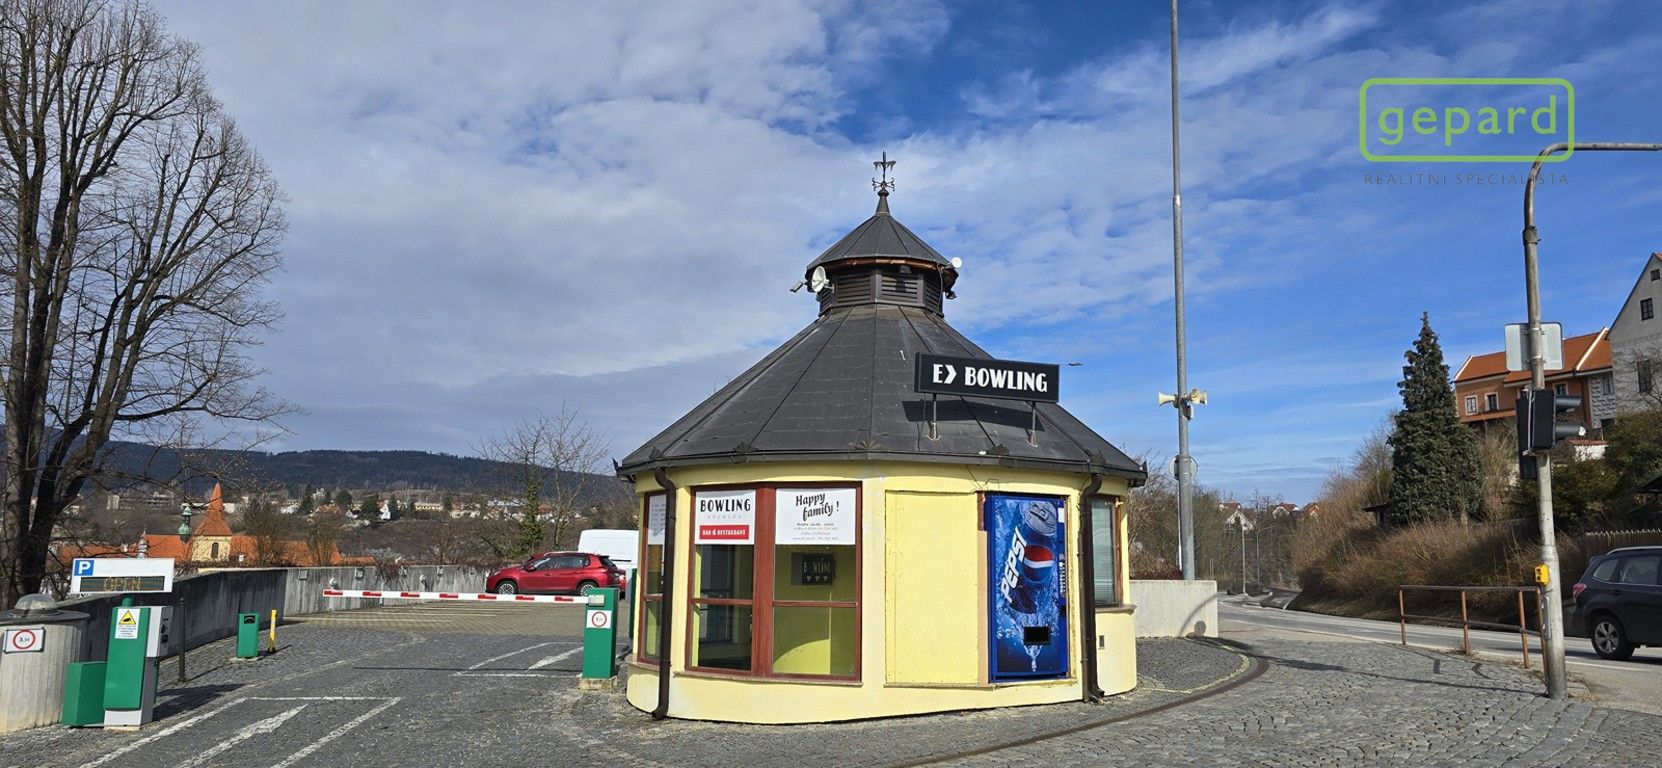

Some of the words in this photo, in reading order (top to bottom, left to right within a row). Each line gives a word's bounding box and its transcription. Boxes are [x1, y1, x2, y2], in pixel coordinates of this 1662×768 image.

[964, 366, 1048, 393] BOWLING
[700, 498, 751, 513] BOWLING
[795, 493, 826, 507] Happy
[802, 502, 834, 522] family
[78, 561, 92, 576] P
[1001, 525, 1027, 604] PEPSI
